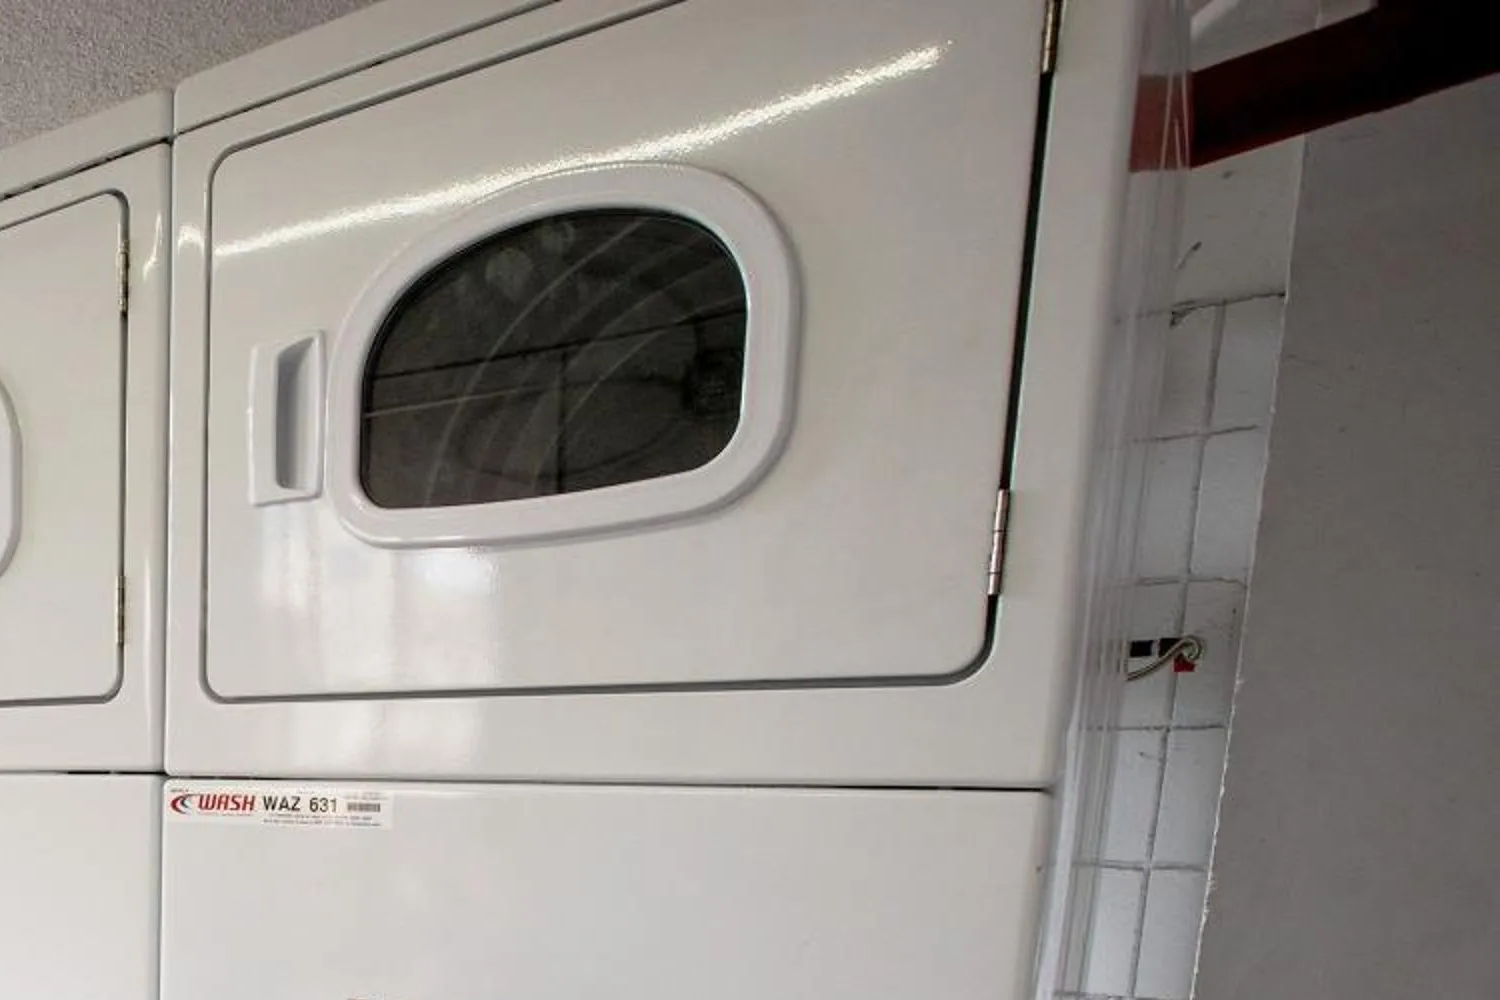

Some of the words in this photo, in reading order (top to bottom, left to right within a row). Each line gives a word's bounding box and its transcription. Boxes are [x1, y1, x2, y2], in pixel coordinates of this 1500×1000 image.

[198, 793, 256, 811] WASH
[263, 795, 301, 811] WAZ
[309, 797, 337, 813] 631
